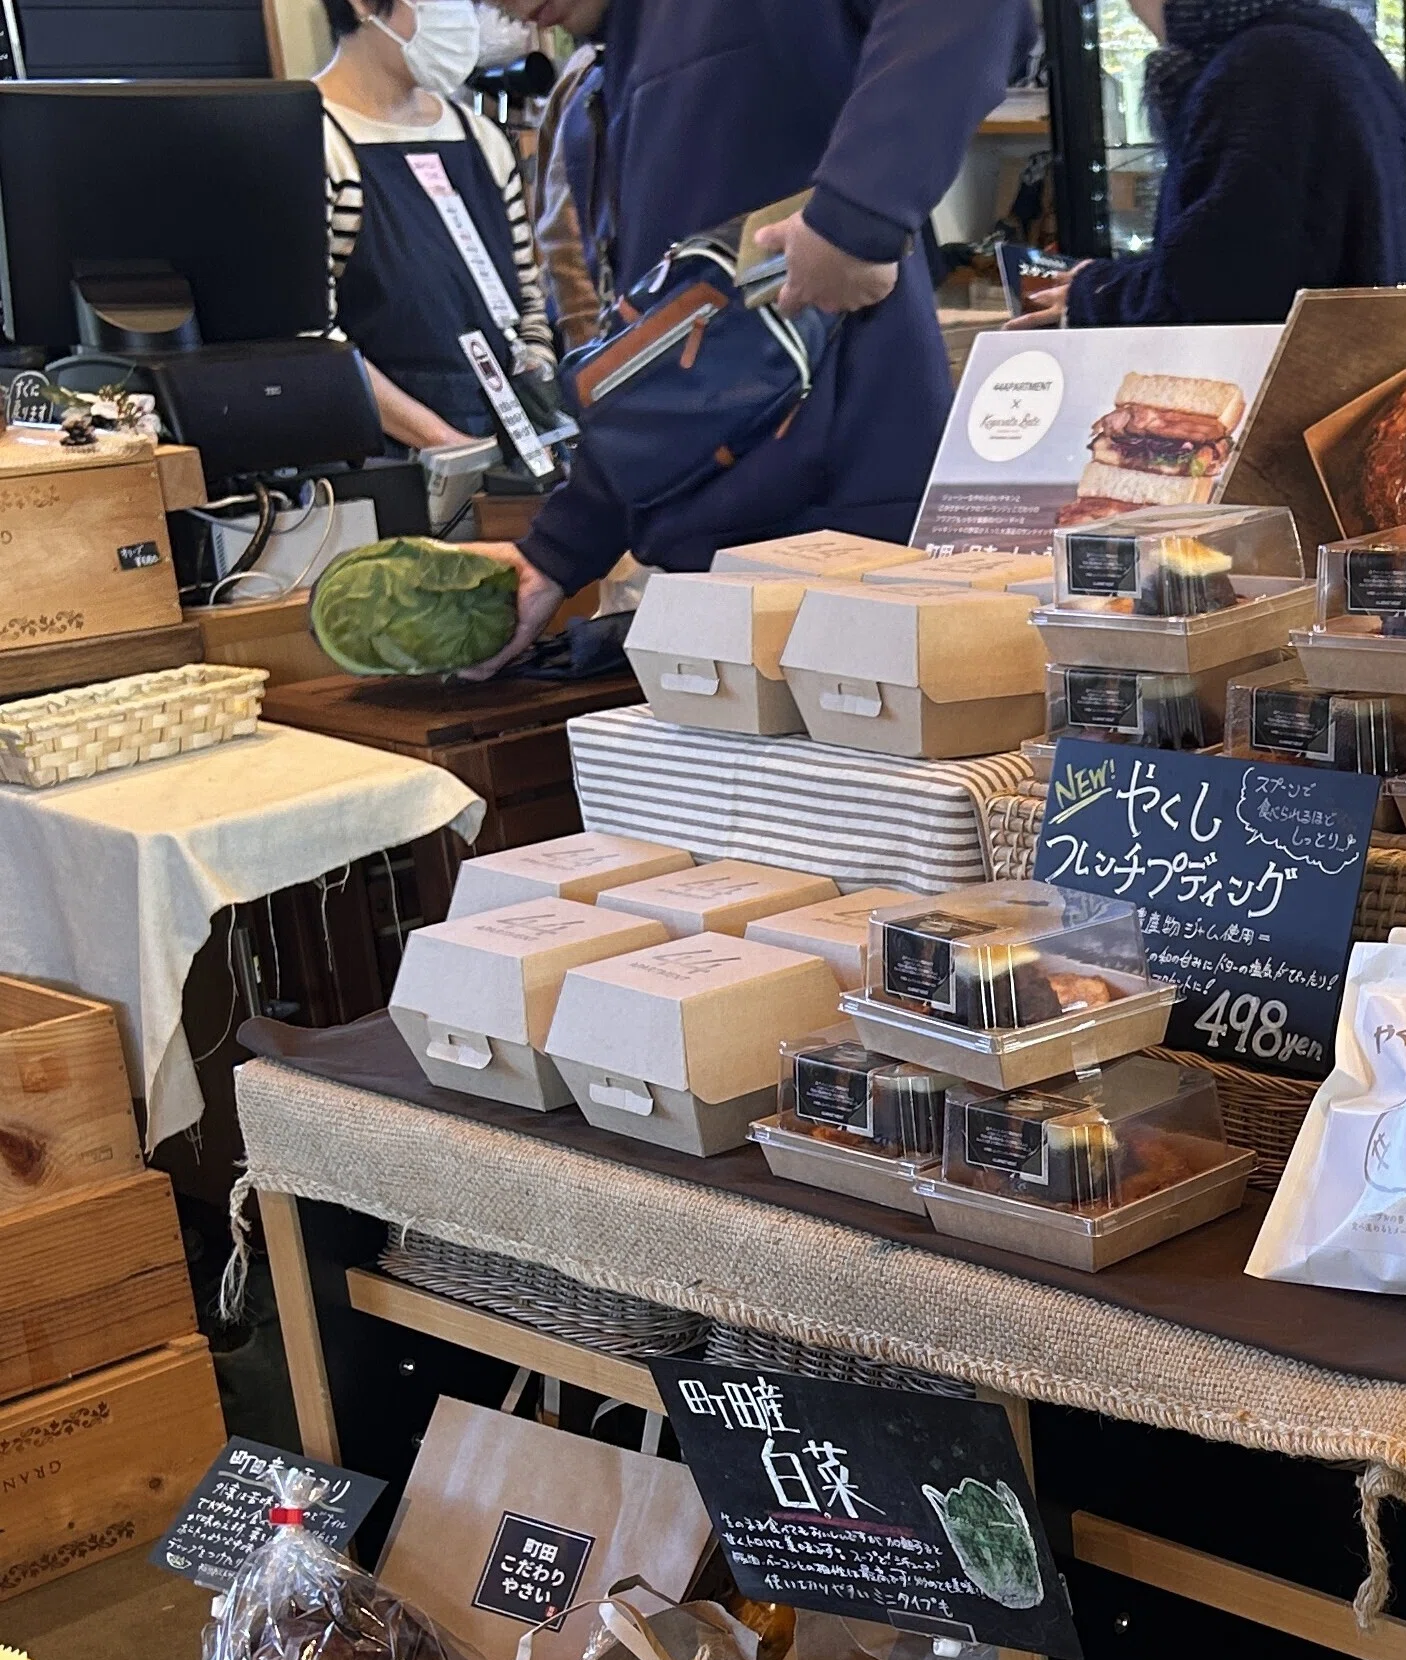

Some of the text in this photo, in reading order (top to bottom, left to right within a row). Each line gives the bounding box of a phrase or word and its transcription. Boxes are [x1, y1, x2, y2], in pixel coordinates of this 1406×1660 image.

[1054, 759, 1222, 843] NEW! やくし
[1045, 834, 1299, 919] フレンチプディング
[678, 1375, 801, 1436] 町田産
[760, 1436, 887, 1519] 白菜
[500, 1554, 565, 1587] こだわり
[522, 1537, 559, 1564] 町田
[501, 1577, 551, 1604] やさい
